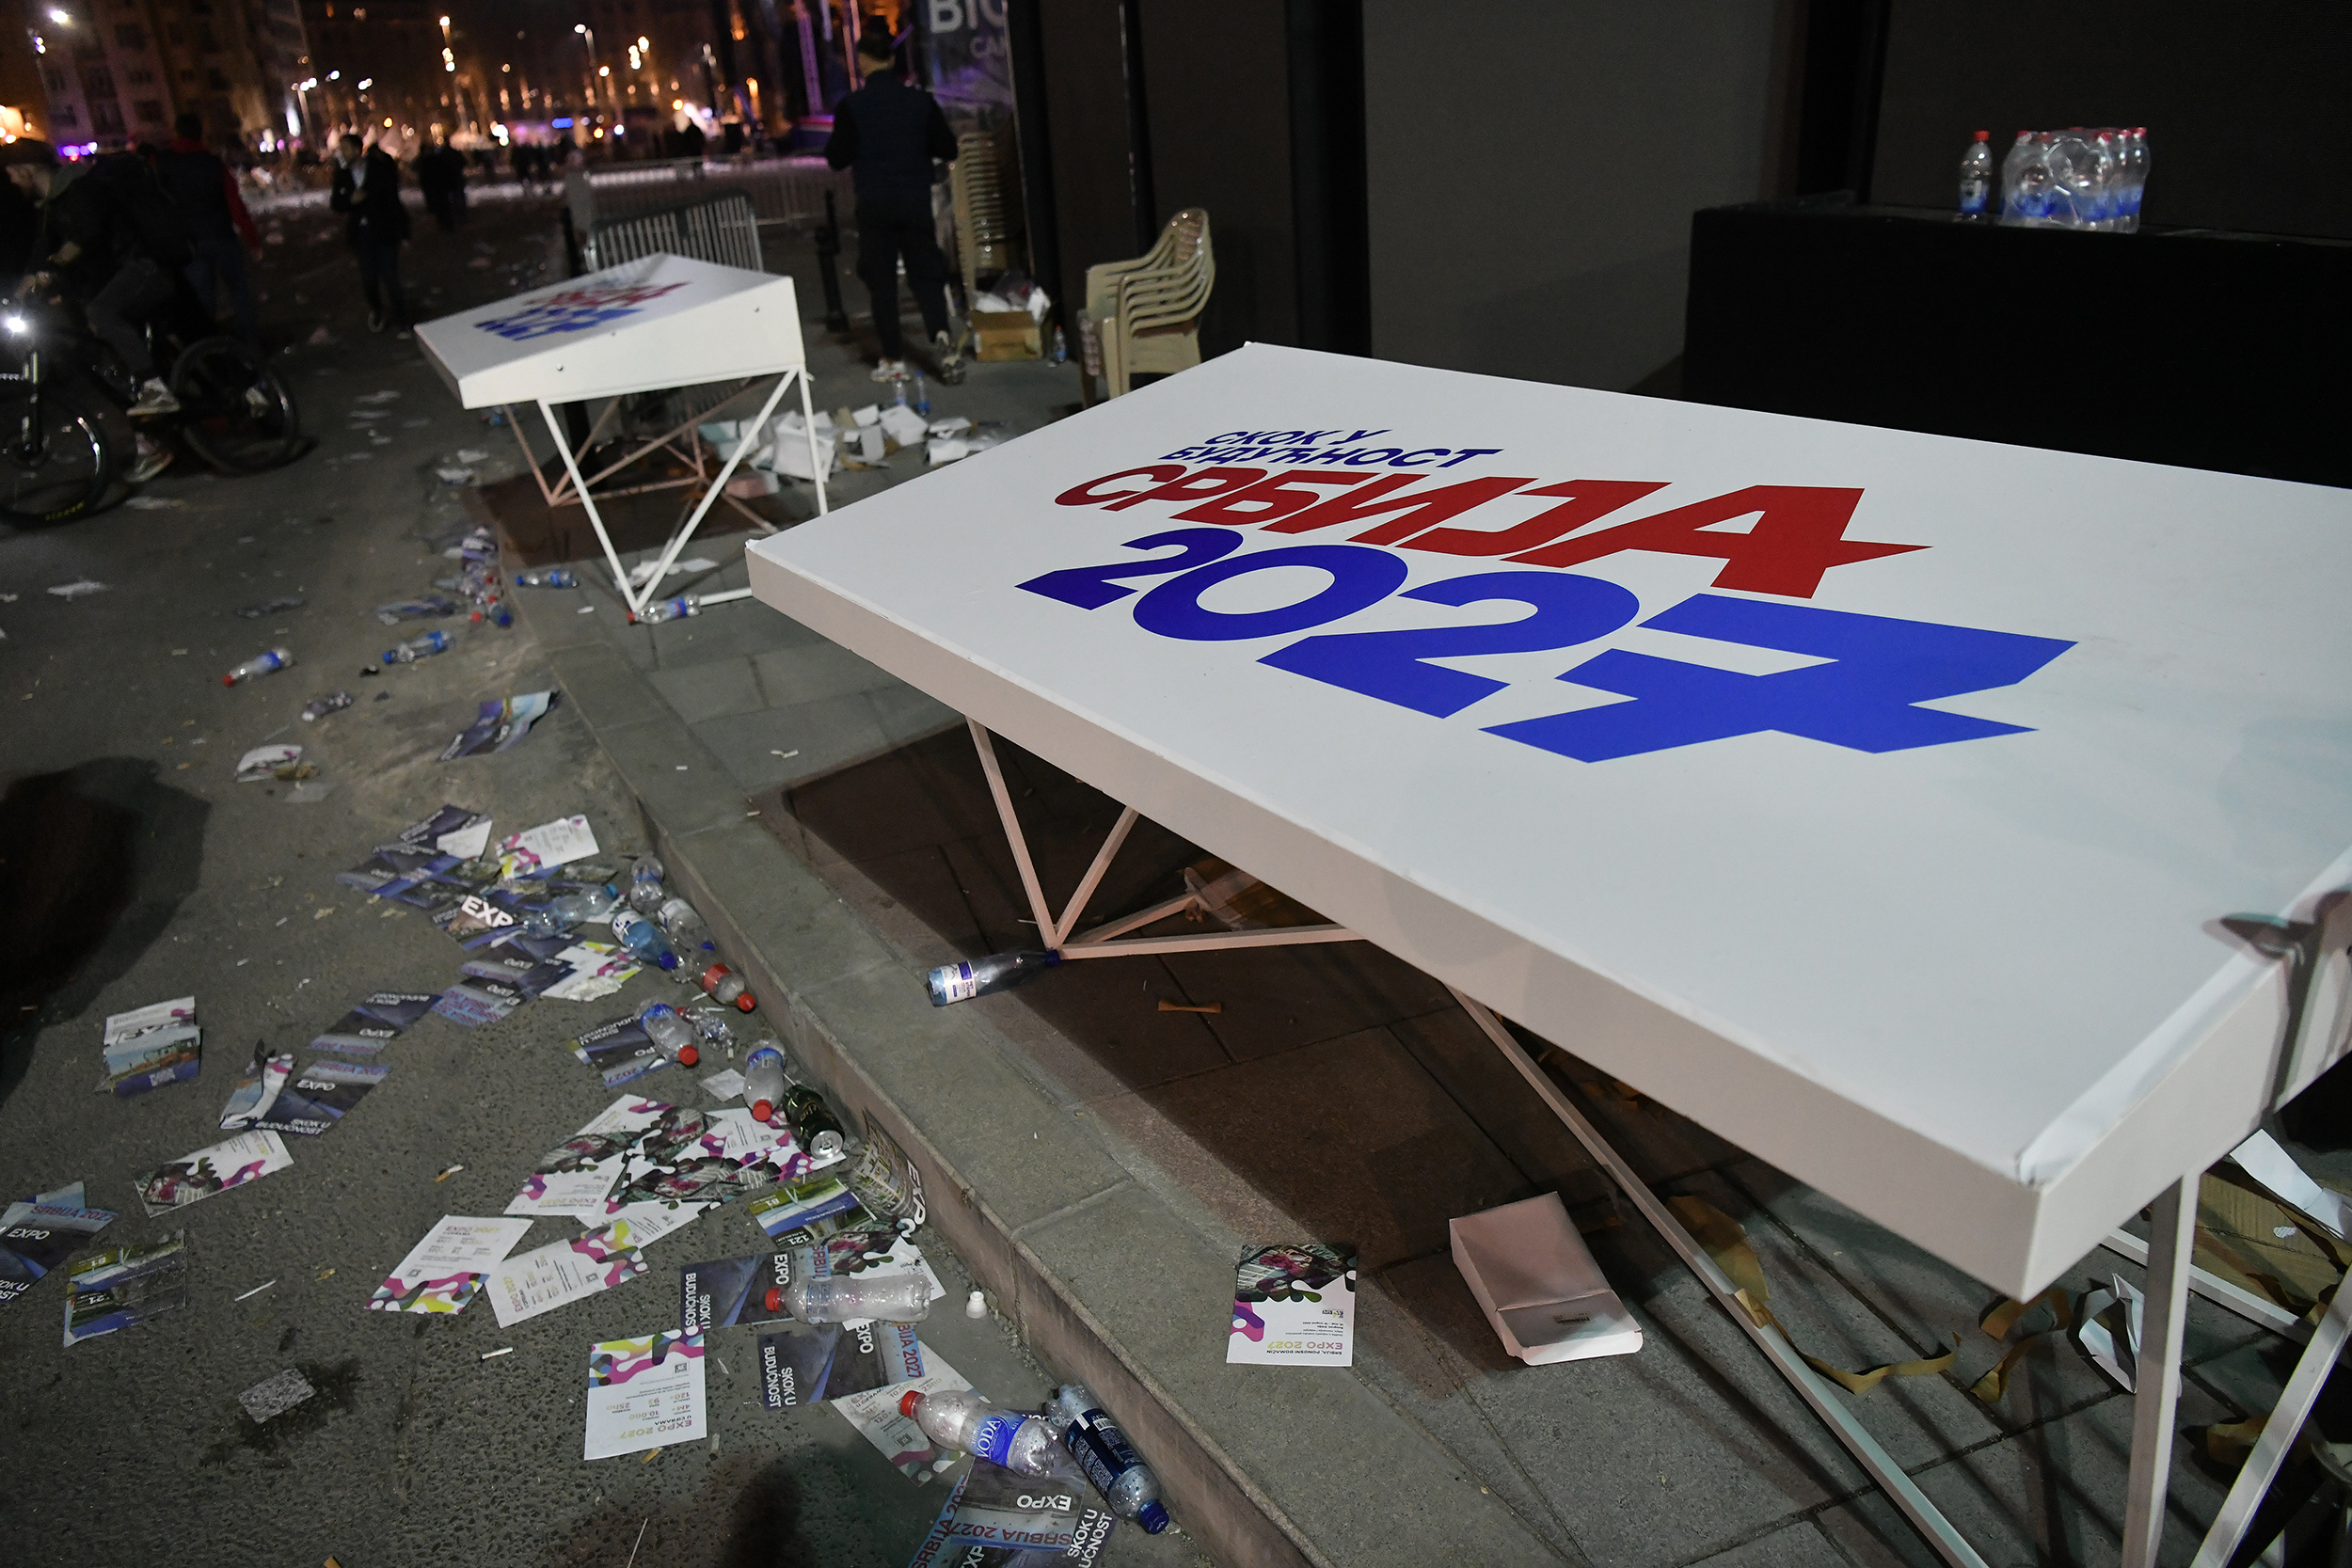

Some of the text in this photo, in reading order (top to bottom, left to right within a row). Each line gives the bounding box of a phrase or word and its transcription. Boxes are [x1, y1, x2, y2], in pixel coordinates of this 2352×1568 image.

[1202, 429, 1392, 446] СКОК У
[1157, 448, 1504, 468] БУДУЋНОСТ
[1054, 464, 1933, 598] СРБИЈА
[1014, 527, 2079, 763] 2027
[461, 895, 514, 928] EXP
[907, 1160, 926, 1225] EXP
[7, 1227, 51, 1240] EXPO
[774, 1253, 790, 1285] EXPO
[812, 1246, 826, 1277] SRBIJ
[685, 1272, 698, 1328] BUDUĆNOS
[856, 1323, 874, 1354] EXPO
[897, 1324, 922, 1378] BIJA 2027
[1267, 1341, 1343, 1350] EXPO 2027
[763, 1346, 782, 1407] BUDUĆNOST
[780, 1367, 797, 1406] SKOK U
[619, 1420, 692, 1439] EXPO 2027
[976, 1418, 1001, 1459] VODA
[1016, 1495, 1073, 1512] EXPO
[945, 1522, 1073, 1545] SRBIJA 2027
[1068, 1509, 1098, 1558] SKOK U
